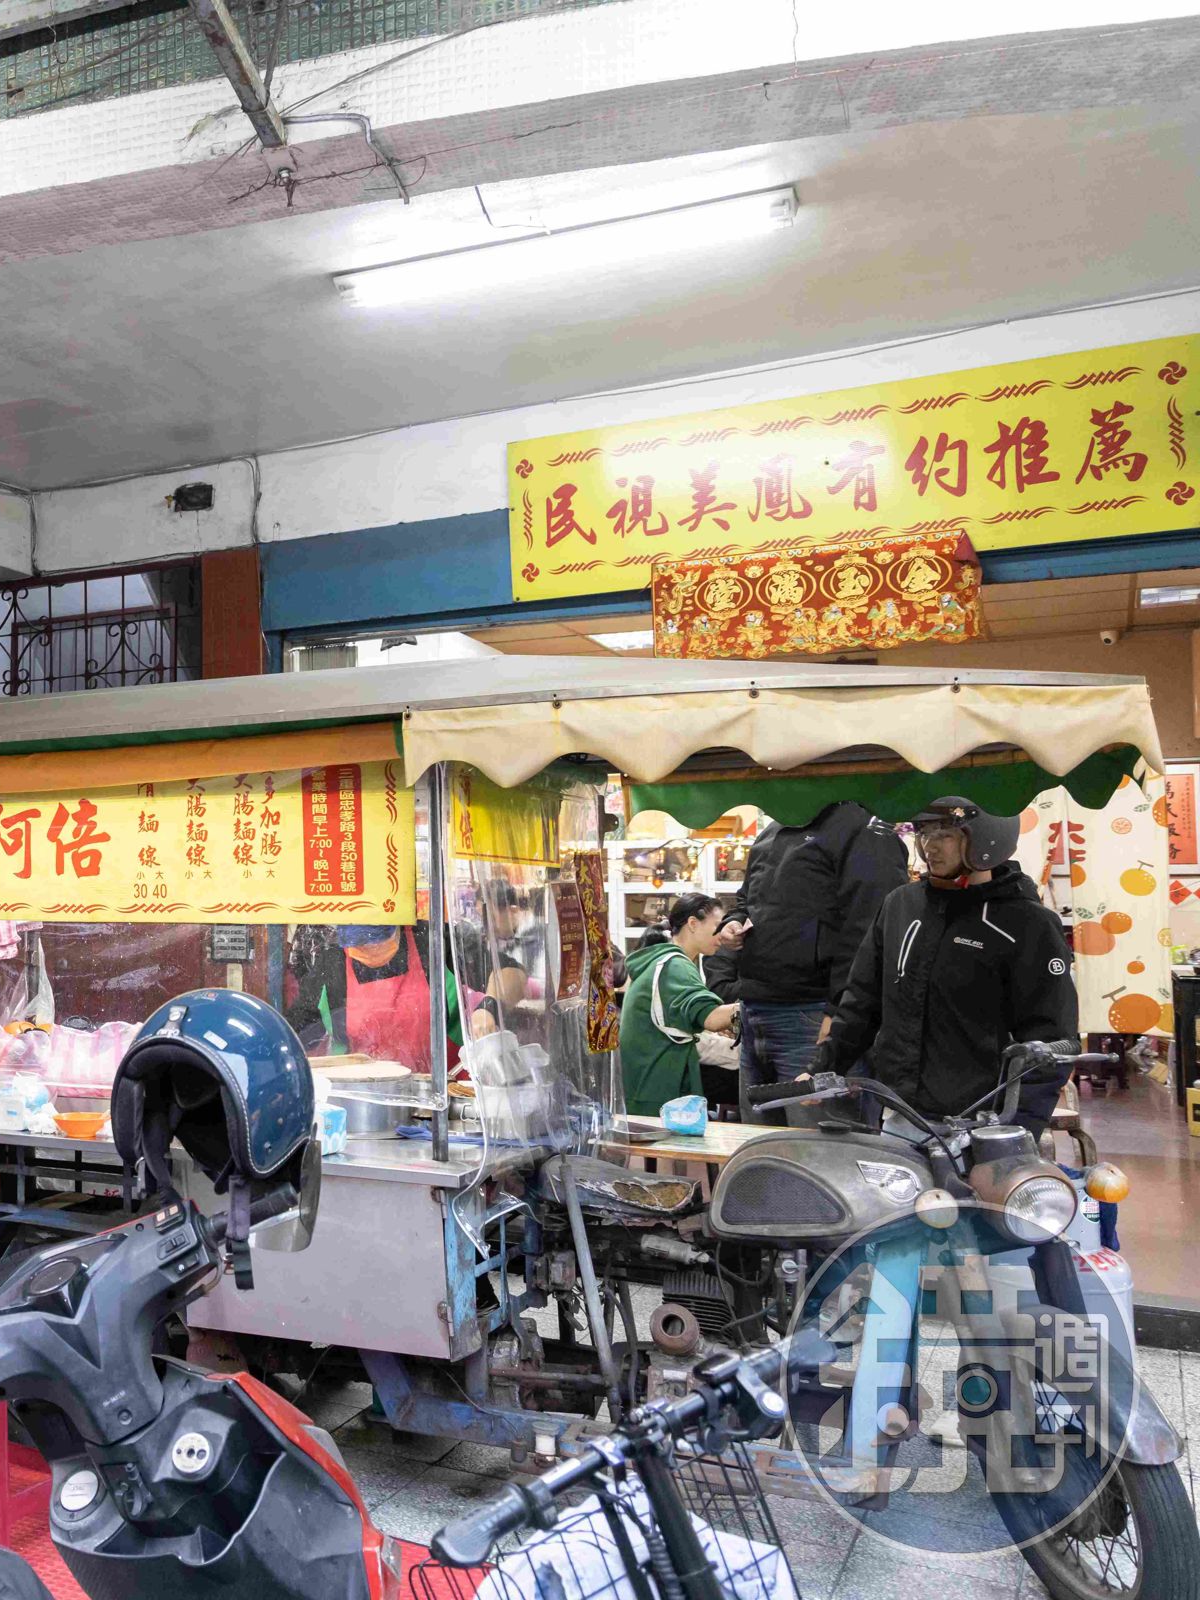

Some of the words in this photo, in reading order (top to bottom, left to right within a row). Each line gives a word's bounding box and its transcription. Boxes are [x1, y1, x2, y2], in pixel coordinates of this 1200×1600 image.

[546, 401, 1149, 548] 民視美鳳有約推薦
[133, 884, 147, 899] 30
[152, 884, 167, 899] 40
